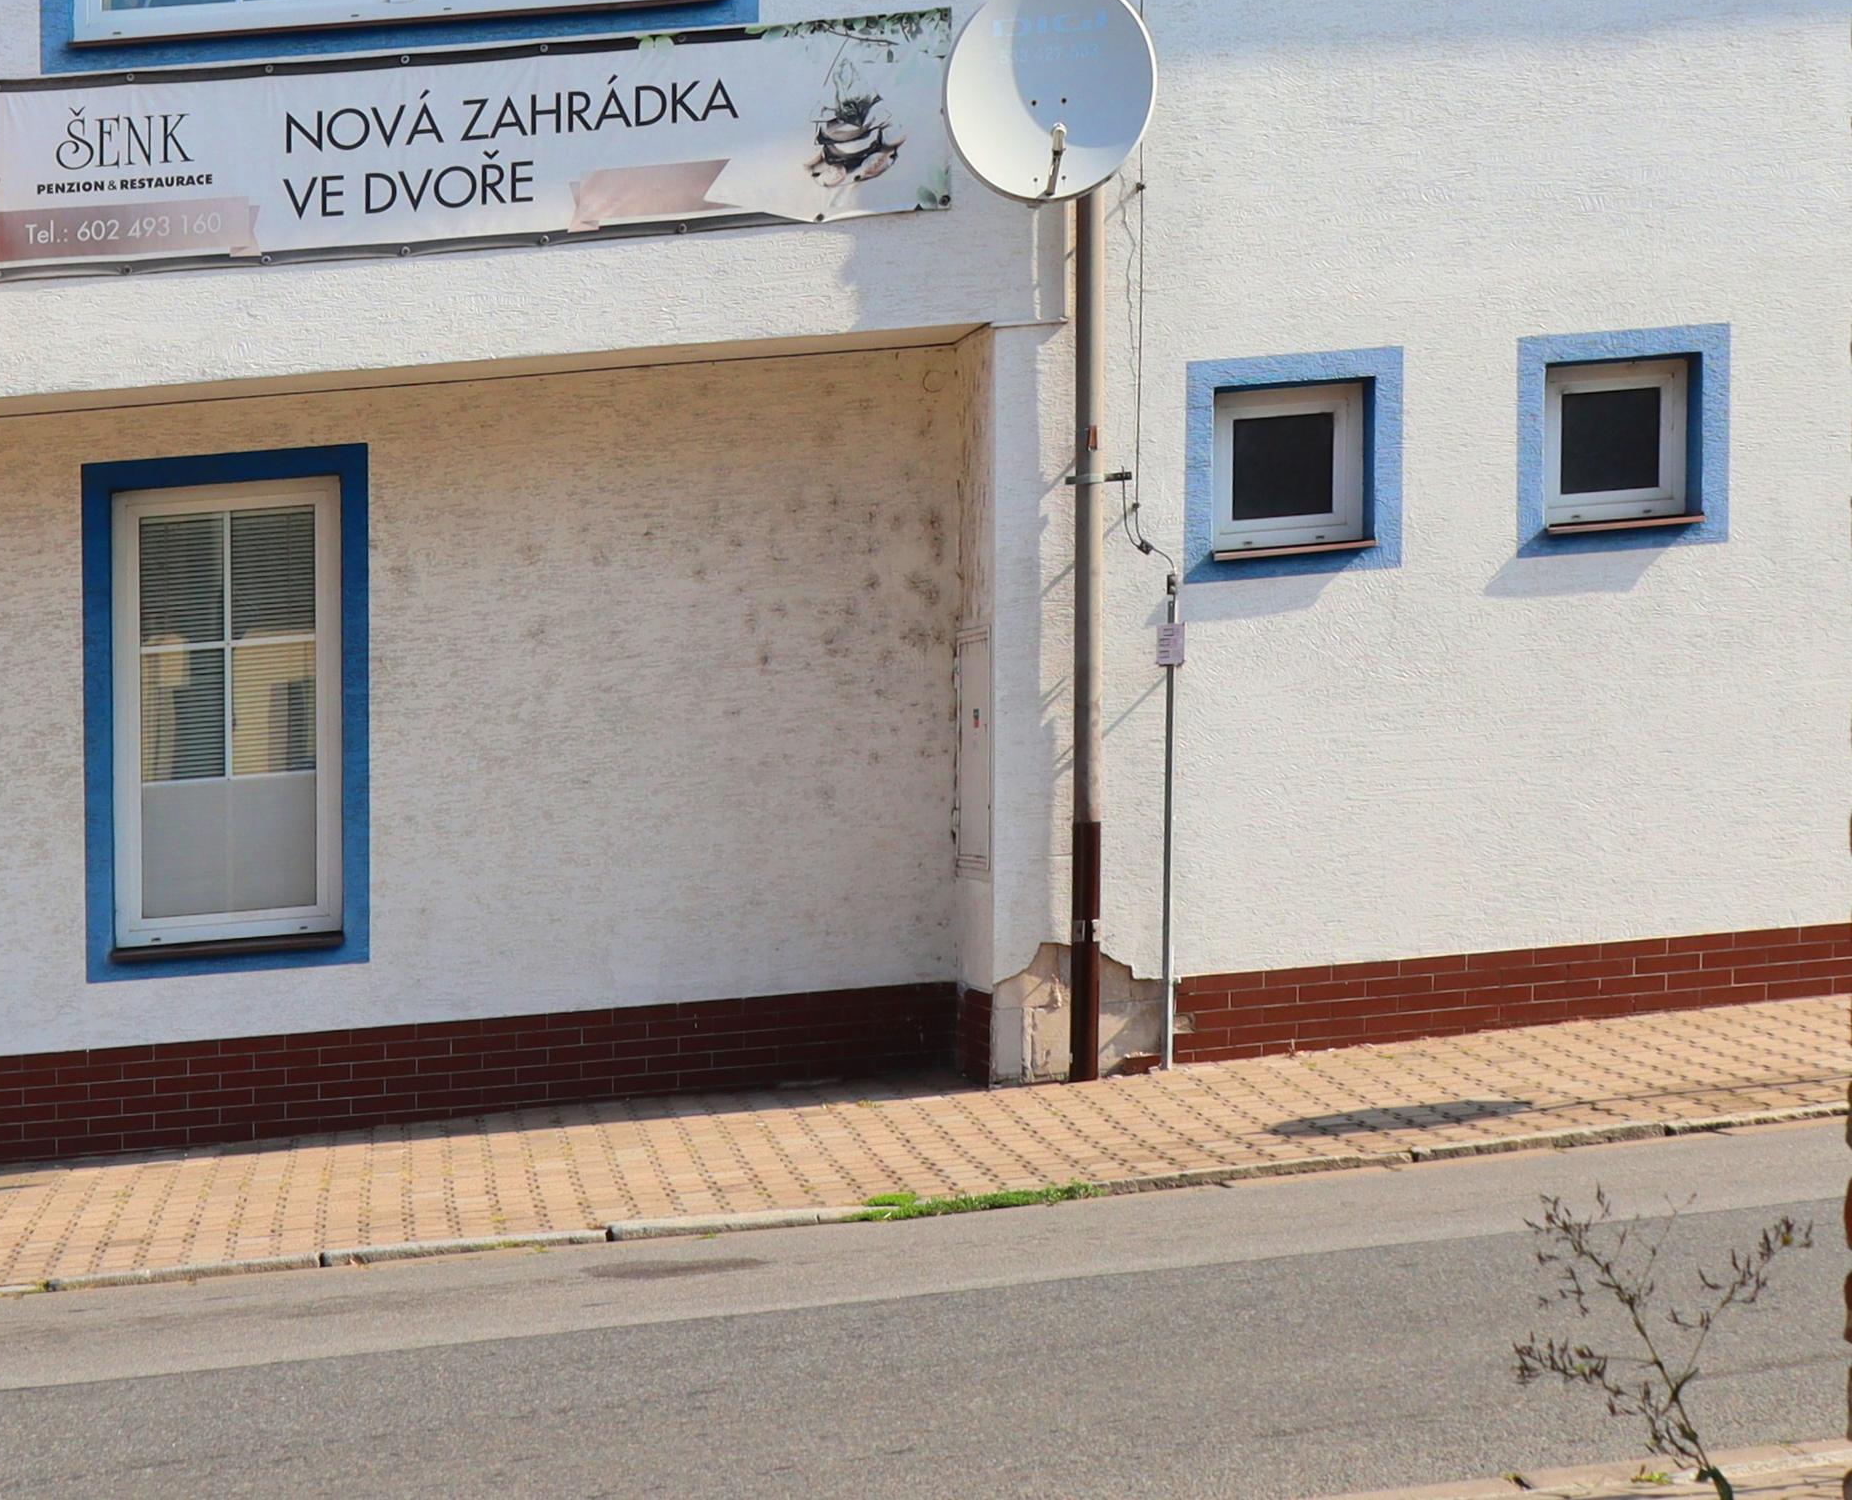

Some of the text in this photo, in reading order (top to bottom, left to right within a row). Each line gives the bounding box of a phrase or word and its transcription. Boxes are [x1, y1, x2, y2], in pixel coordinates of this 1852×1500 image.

[55, 106, 195, 170] ŠENK
[284, 75, 738, 154] NOVÁ ZAHRÁDKA
[37, 174, 213, 195] PENZION & RESTAURACE
[284, 150, 535, 221] VE DVOŘE
[25, 212, 222, 245] Tel.: 602 493 160
